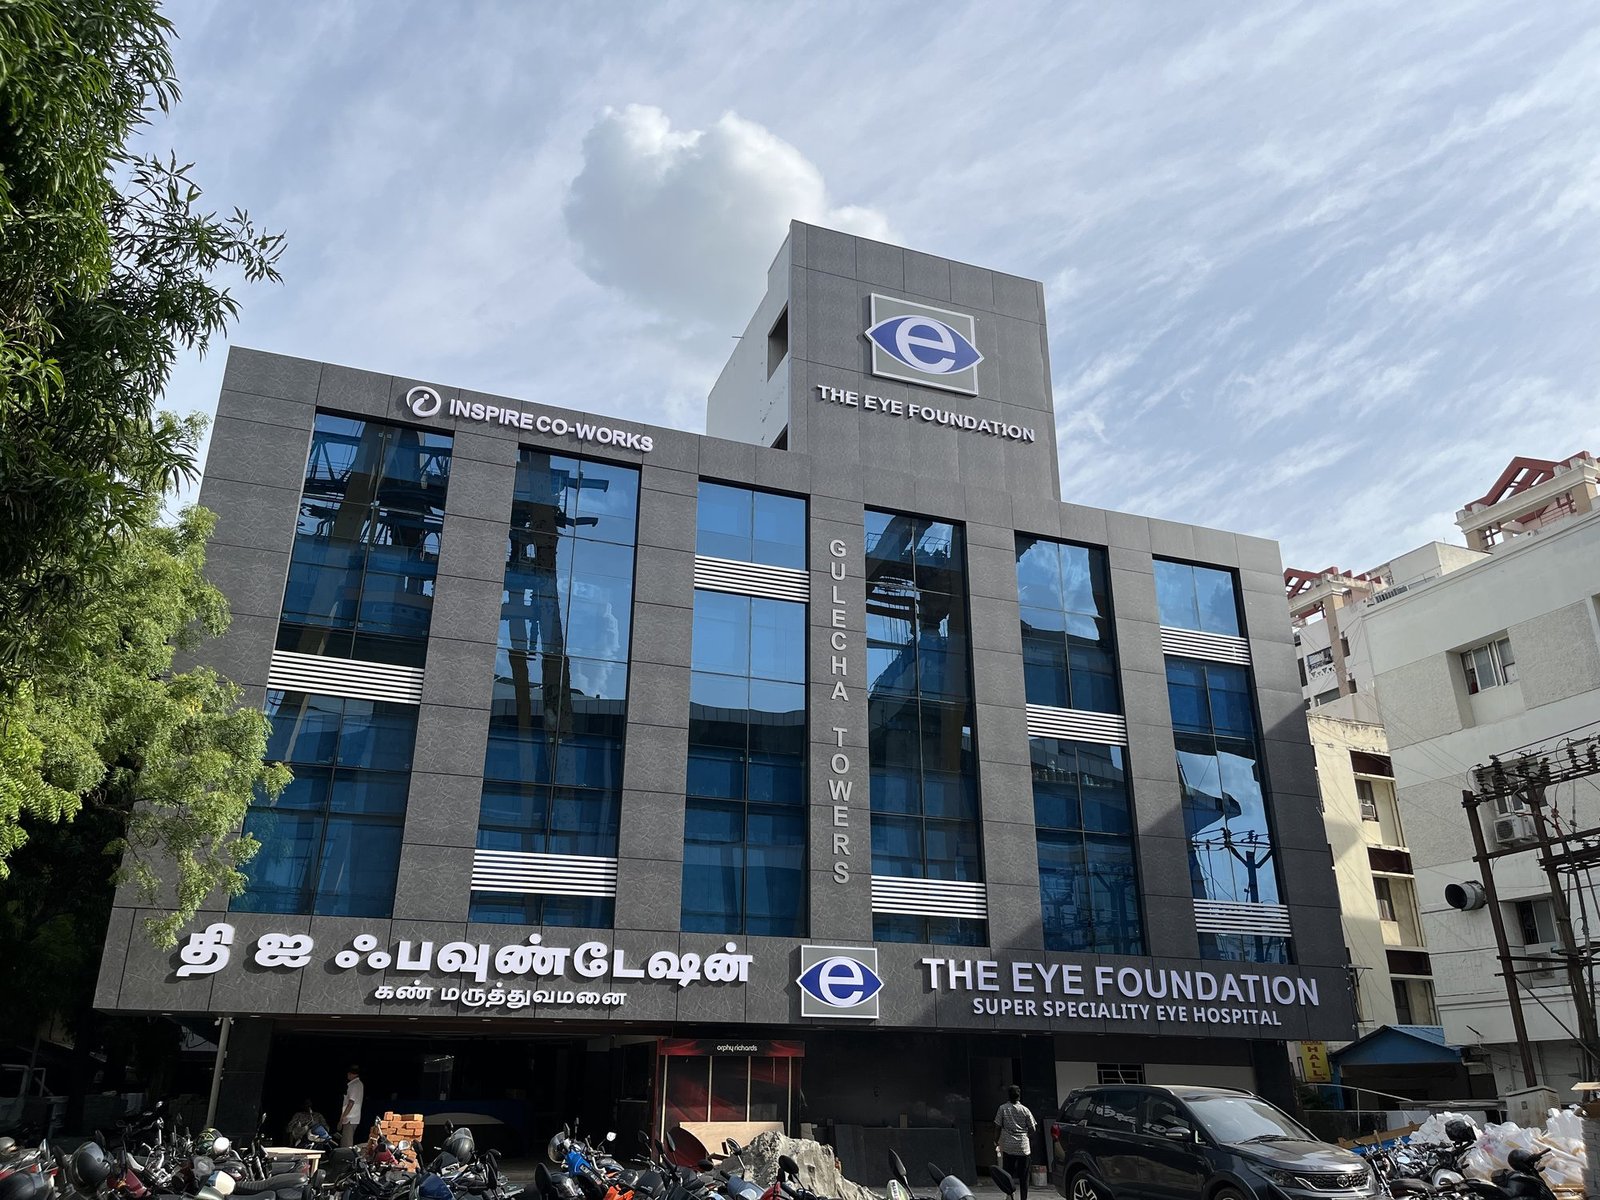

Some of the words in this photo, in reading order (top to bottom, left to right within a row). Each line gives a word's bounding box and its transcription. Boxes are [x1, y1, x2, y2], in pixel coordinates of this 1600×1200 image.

[450, 399, 533, 430] INSPIRE
[536, 415, 654, 452] CO-WORKS
[817, 384, 858, 405] THE
[864, 394, 902, 415] EYE
[908, 404, 1035, 442] FOUNDATION
[829, 539, 849, 702] GULECHA
[828, 726, 852, 884] TOWERS
[176, 922, 235, 977] தி
[254, 932, 314, 968] ஐ
[335, 933, 753, 988] ஃபவுண்டேஷன்
[374, 979, 434, 1000] கண்
[440, 982, 627, 1009] மருத்துவமனை
[922, 958, 999, 991] THE
[1011, 961, 1084, 995] EYE
[1095, 965, 1319, 1006] FOUNDATION
[973, 997, 1037, 1016] SUPER
[1043, 1001, 1150, 1020] SPECIALITY
[1157, 1005, 1188, 1022] EYE
[1193, 1007, 1282, 1026] HOSPITAL
[1307, 1046, 1322, 1077] HALL
